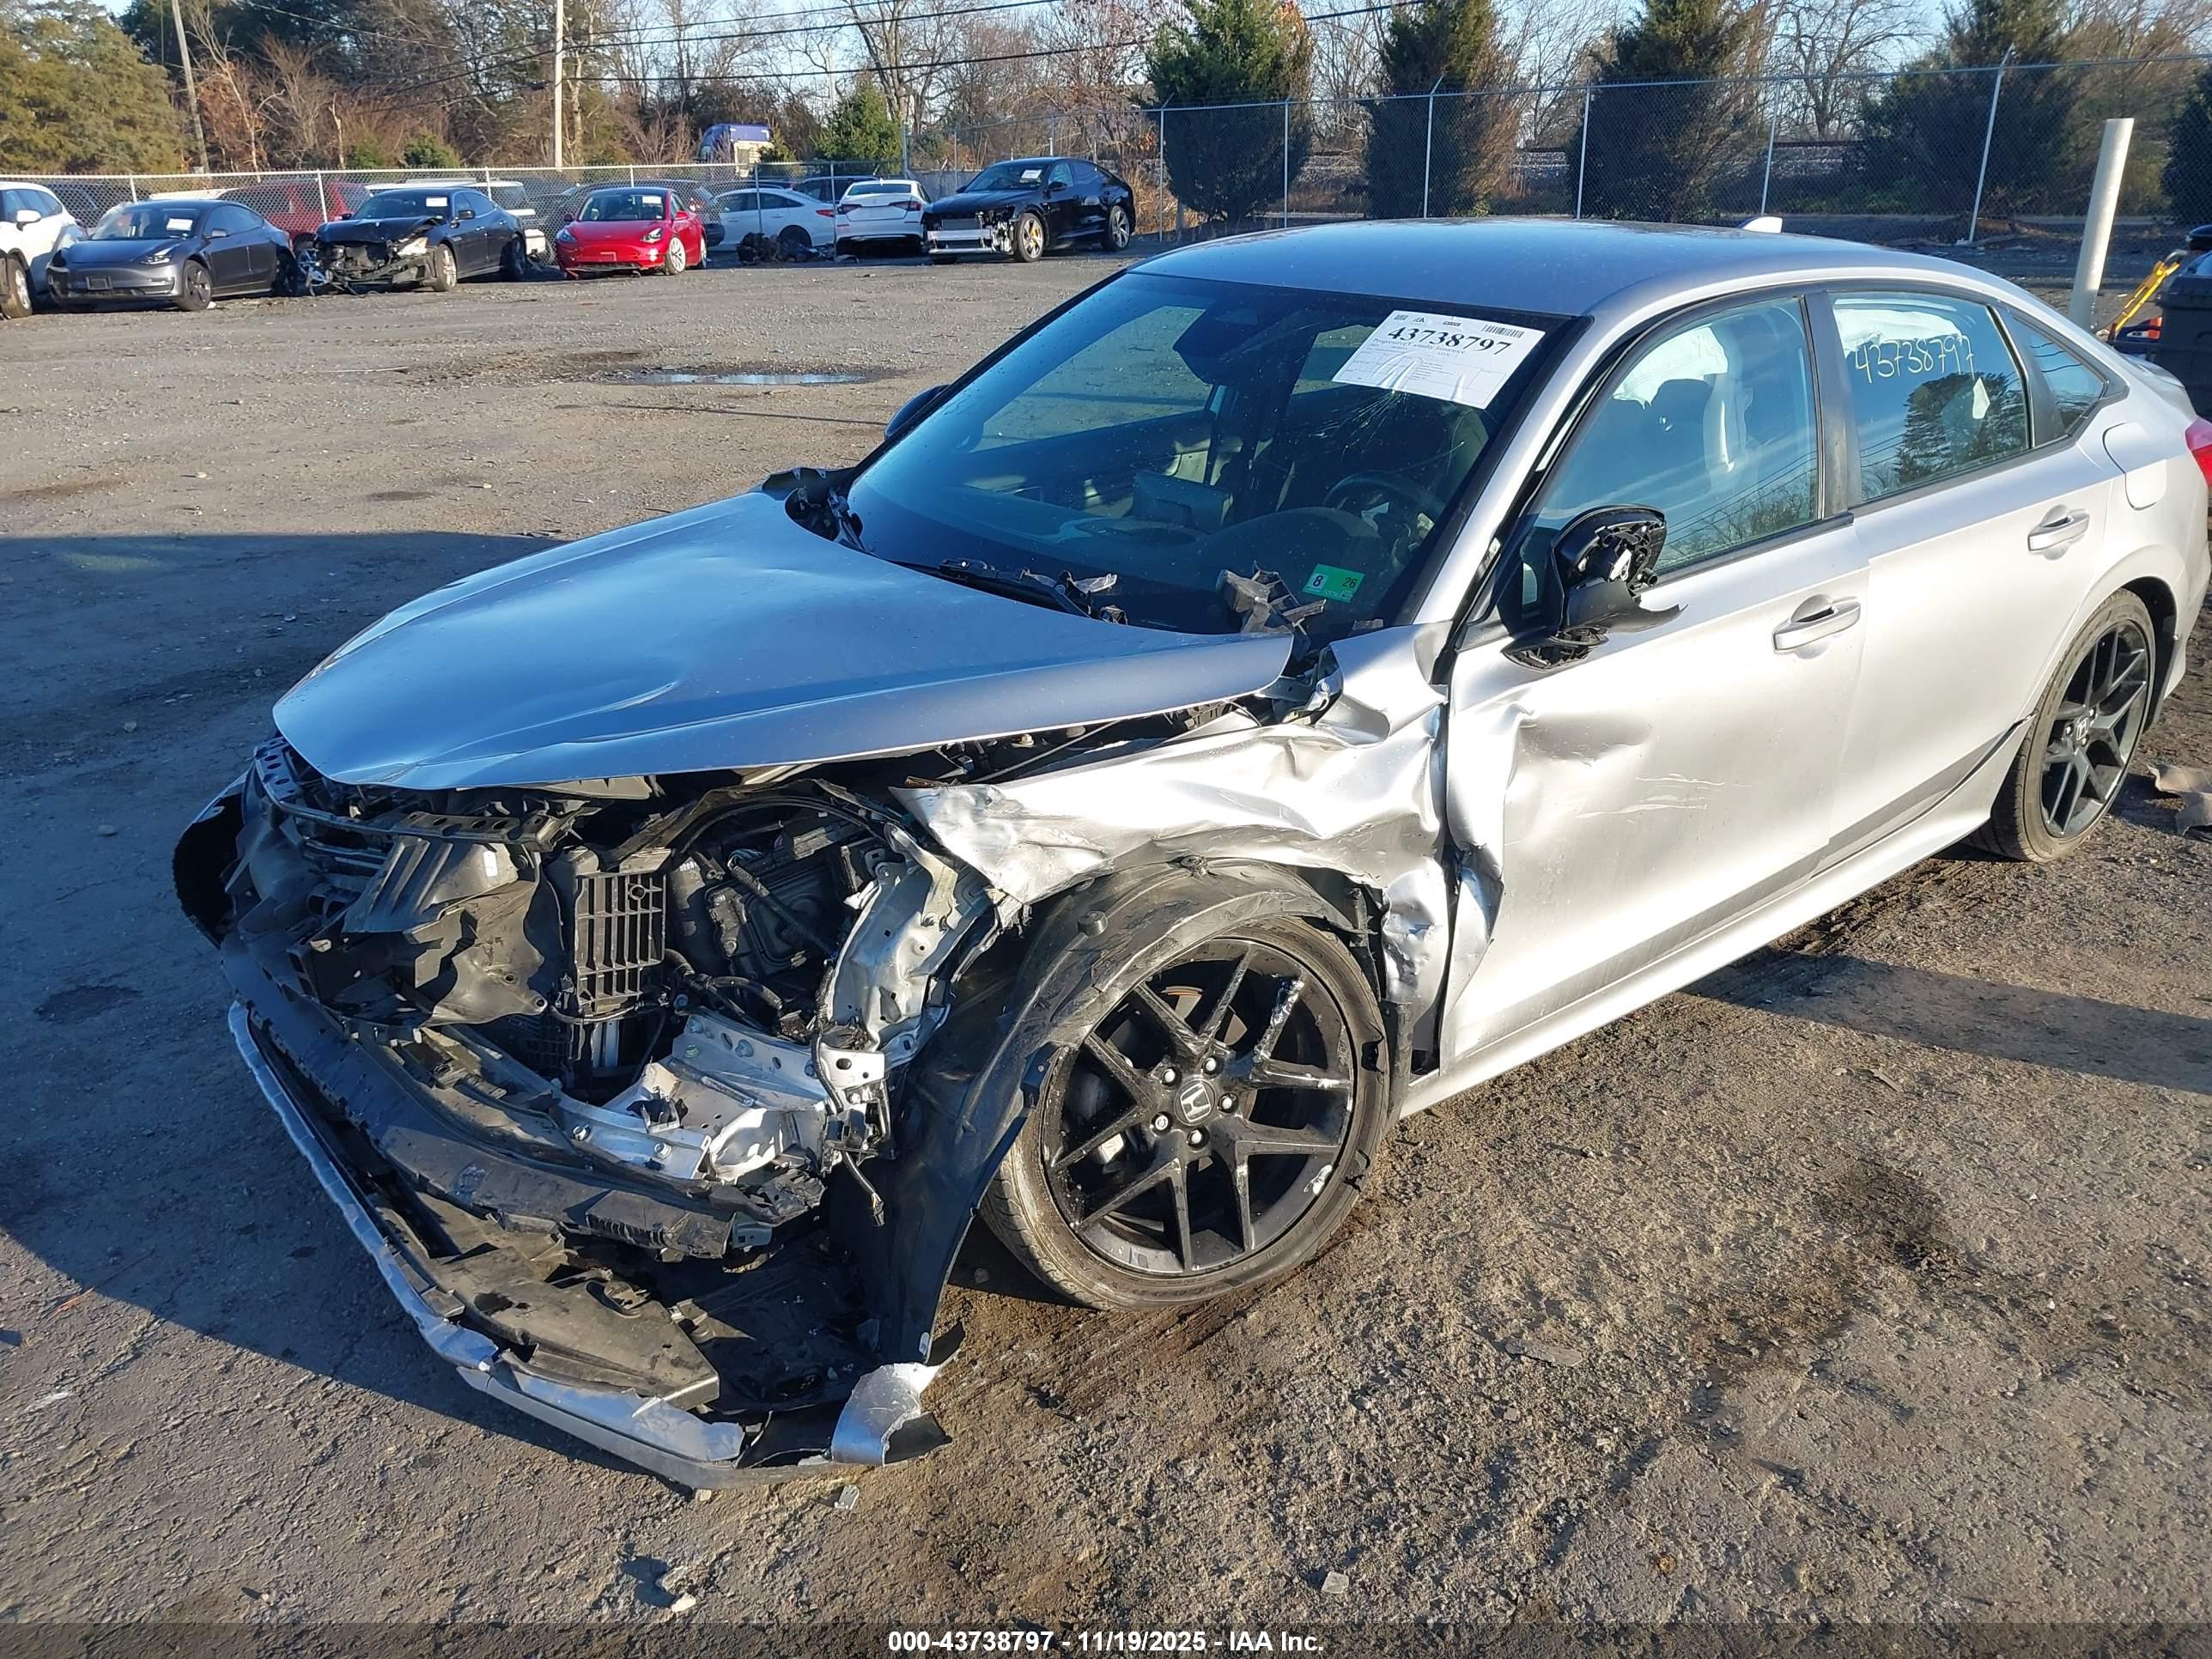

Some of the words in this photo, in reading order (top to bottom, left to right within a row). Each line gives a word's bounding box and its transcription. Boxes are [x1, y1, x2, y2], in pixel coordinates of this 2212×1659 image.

[1388, 326, 1513, 356] 43738797
[1855, 335, 1975, 384] 43738797
[1313, 575, 1323, 586] 8
[1343, 577, 1358, 588] 26
